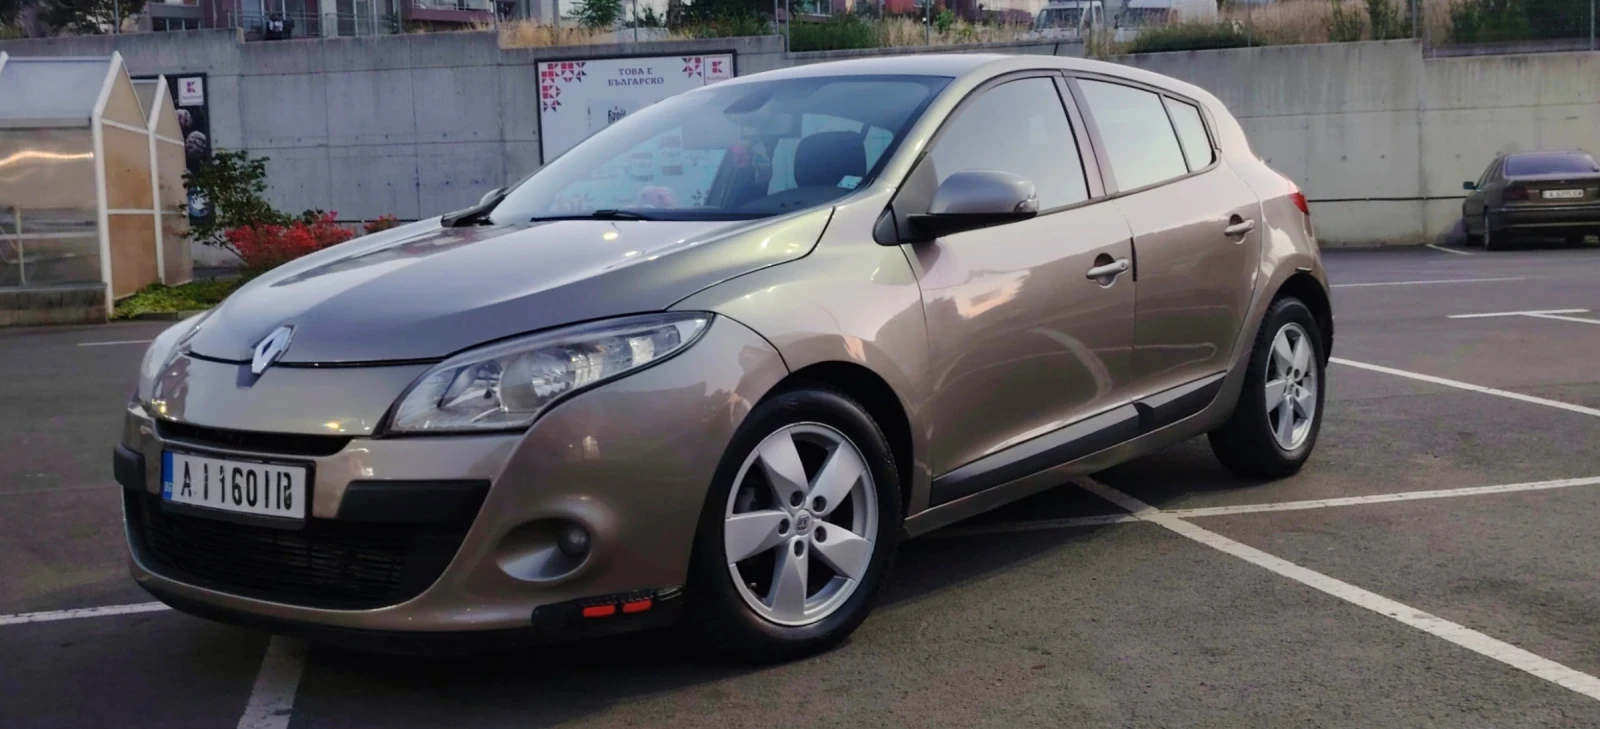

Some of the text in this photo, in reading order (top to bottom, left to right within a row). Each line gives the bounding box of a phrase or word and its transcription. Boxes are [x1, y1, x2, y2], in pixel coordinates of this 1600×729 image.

[618, 67, 652, 75] ТОВА Е
[608, 77, 664, 86] БЪЛГАРСКО
